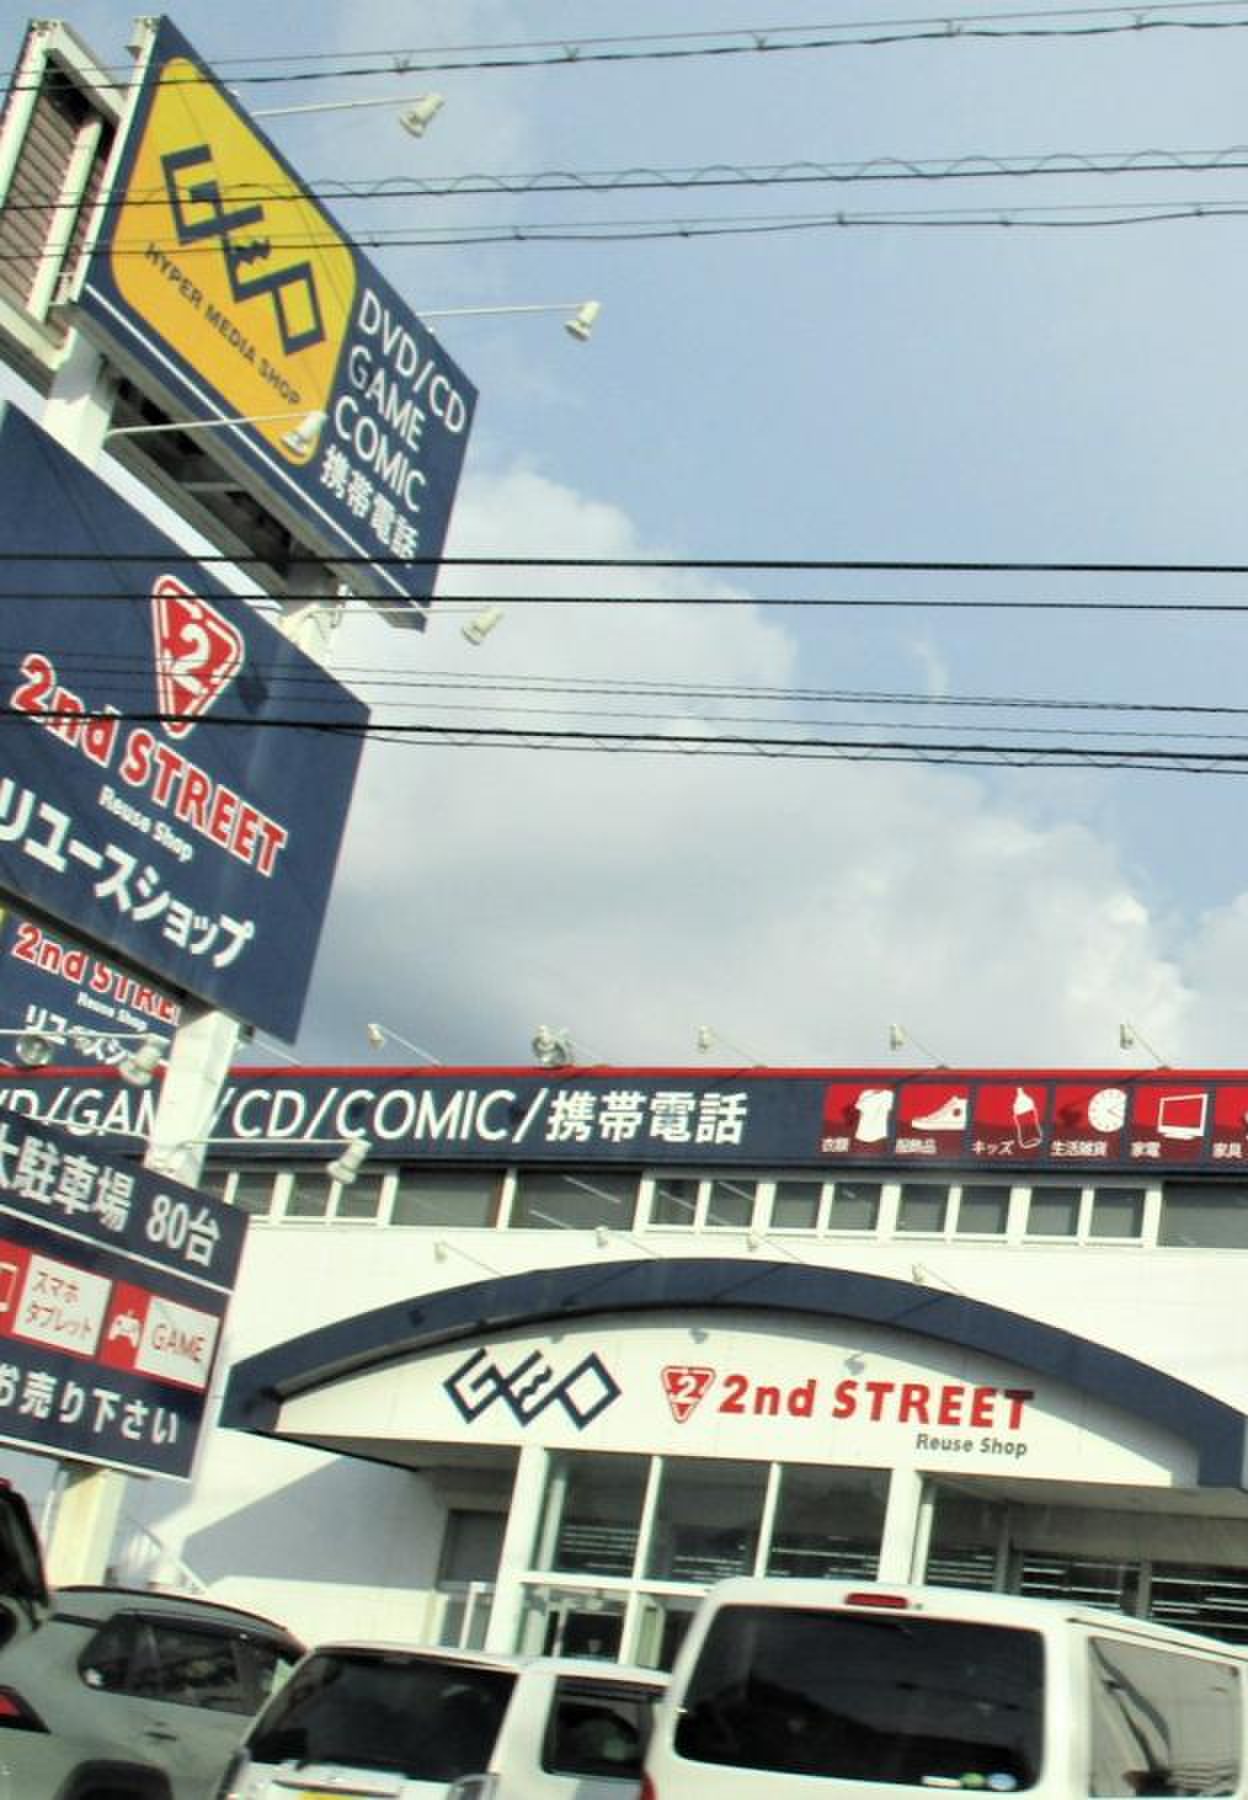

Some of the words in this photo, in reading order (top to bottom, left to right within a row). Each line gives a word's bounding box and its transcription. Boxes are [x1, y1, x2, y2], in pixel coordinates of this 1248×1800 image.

[144, 242, 204, 312] HYPER
[205, 303, 256, 366] MEDIA
[257, 357, 302, 405] SHOP
[358, 288, 467, 433] DVD/CD
[349, 345, 426, 452] GAME
[334, 395, 427, 513] COMIC
[320, 444, 420, 568] 携帯電話
[10, 653, 123, 768] 2nd
[119, 728, 289, 878] STREET
[99, 786, 150, 837] Reuse
[150, 821, 193, 863] Shop
[11, 922, 89, 984] 2nd
[973, 1140, 1015, 1156] キッズ
[146, 1194, 221, 1267] 80台
[25, 1301, 93, 1341] タブレット
[32, 1269, 80, 1305] スマホ
[152, 1321, 206, 1364] GAME
[719, 1374, 817, 1418] 2nd
[832, 1380, 1034, 1430] STREET
[916, 1432, 972, 1454] Reuse
[980, 1436, 1028, 1457] Shop
